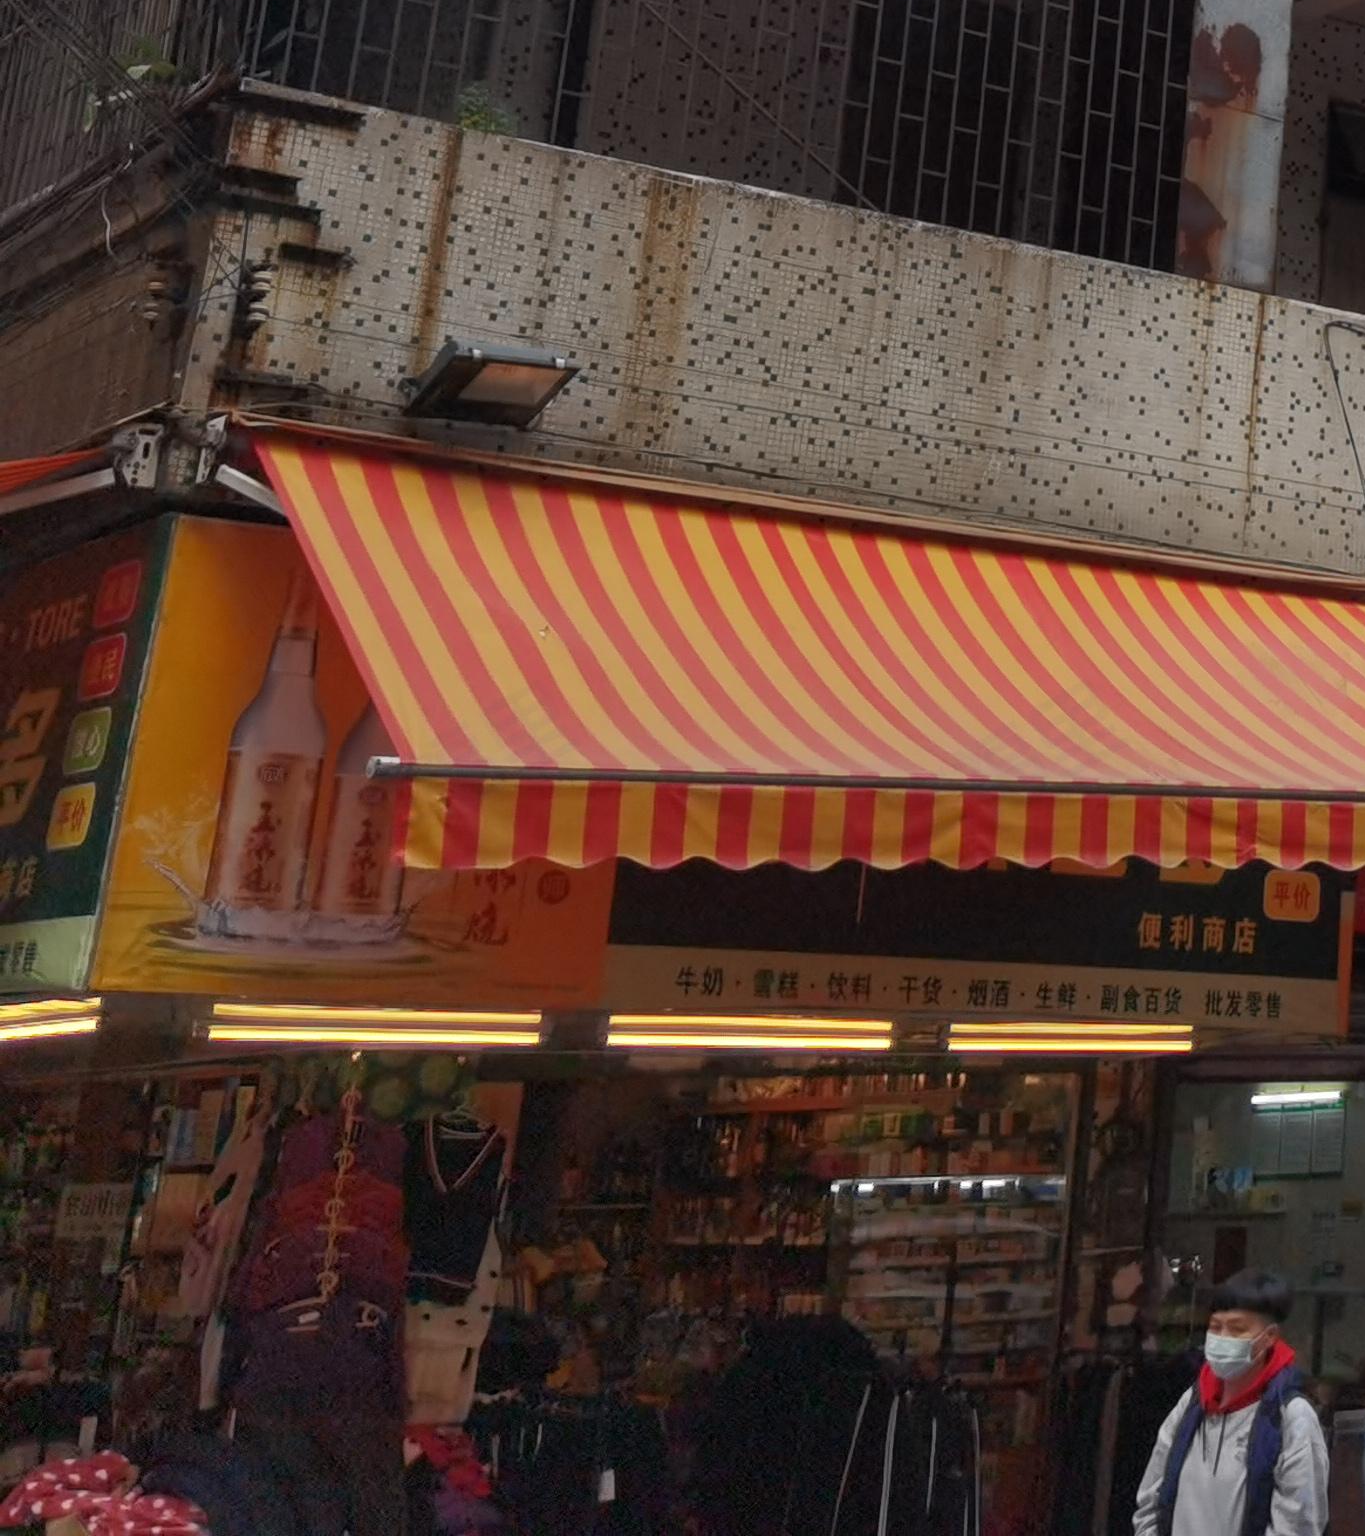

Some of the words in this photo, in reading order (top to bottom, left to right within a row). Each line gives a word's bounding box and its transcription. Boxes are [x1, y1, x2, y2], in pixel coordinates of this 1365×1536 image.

[1272, 880, 1315, 912] 平价
[1136, 910, 1260, 955] 便利商店
